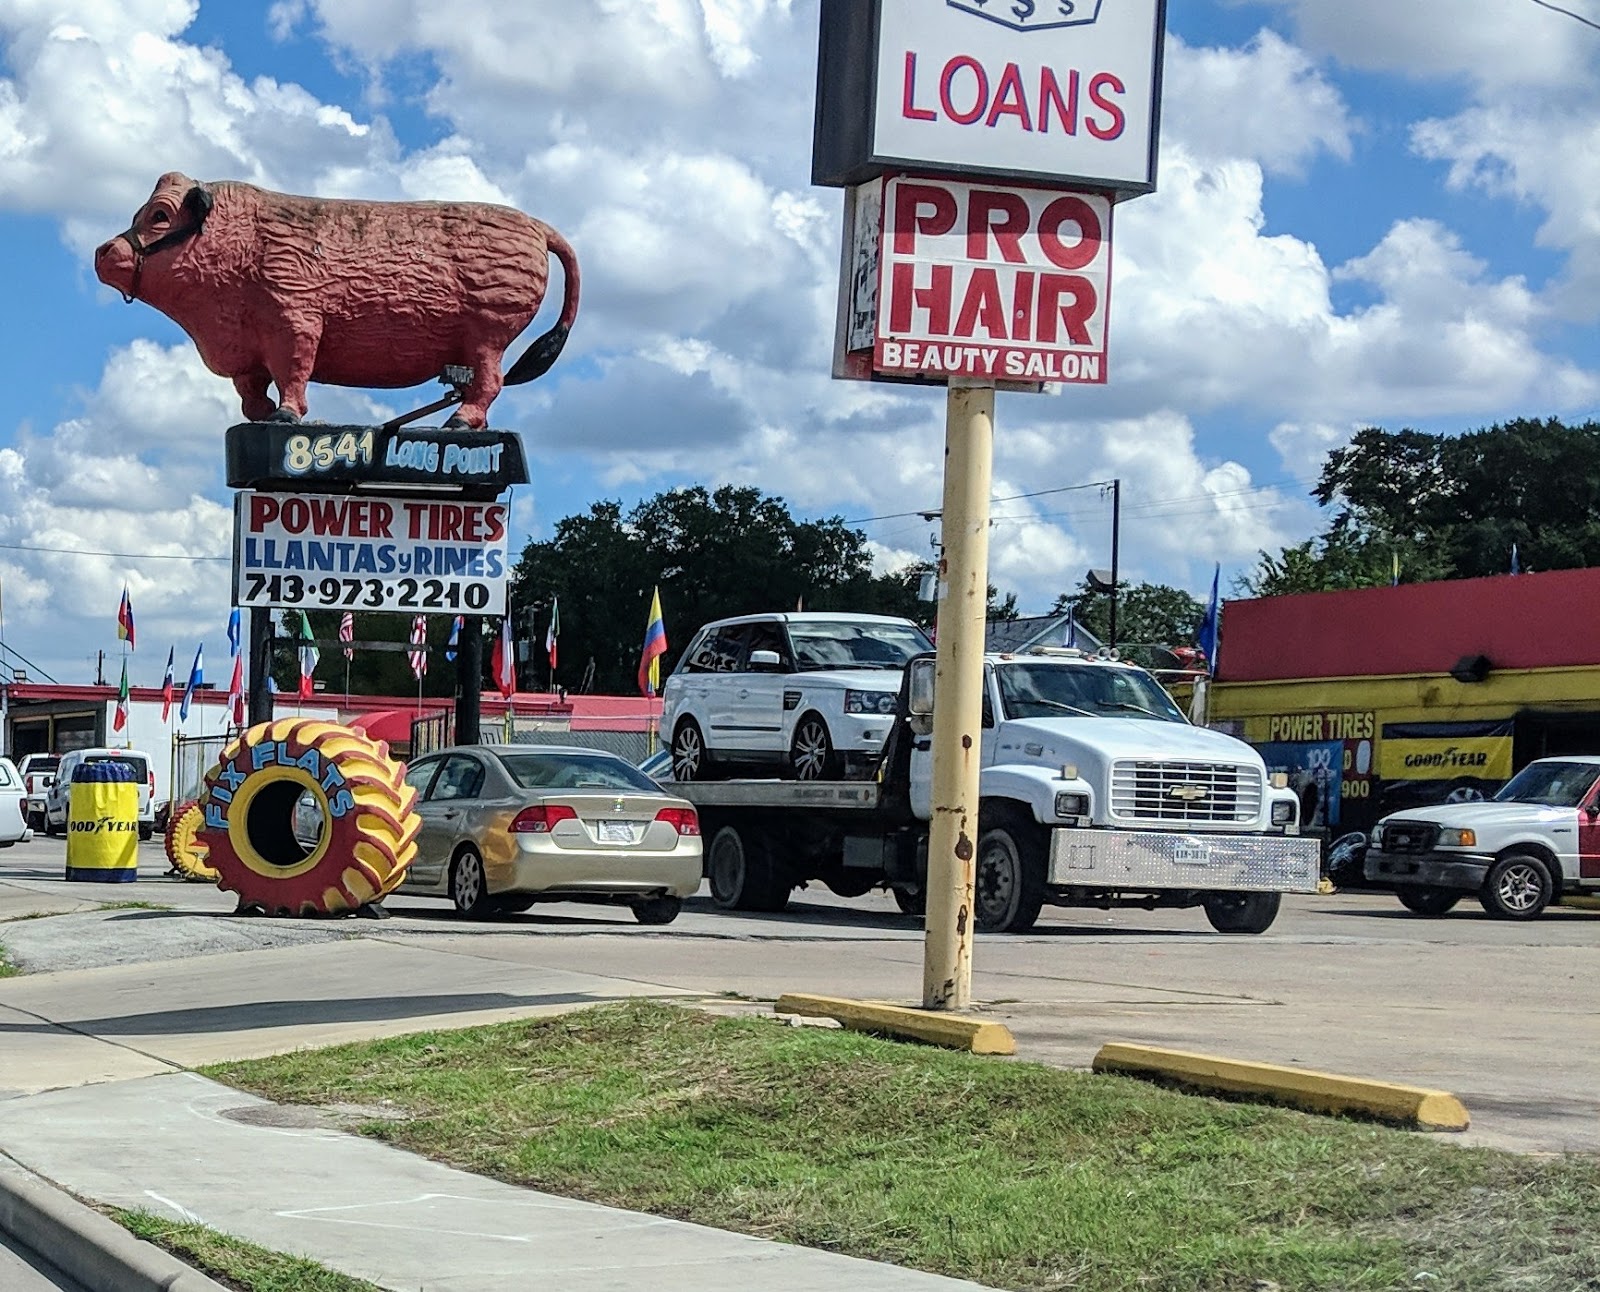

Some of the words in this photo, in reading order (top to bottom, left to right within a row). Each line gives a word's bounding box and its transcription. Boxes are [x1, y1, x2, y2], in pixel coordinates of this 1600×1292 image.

[902, 51, 1126, 141] LOANS
[893, 183, 1102, 270] PRO
[889, 262, 1097, 346] HAIR
[882, 342, 999, 374] BEAUTY
[1005, 350, 1099, 380] SALON
[285, 430, 373, 473] 8541
[386, 435, 439, 472] LONG
[442, 442, 504, 474] POINT
[250, 496, 393, 538] POWER
[404, 501, 505, 542] TIRES
[1270, 715, 1323, 740] POWER
[1327, 712, 1374, 738] TIRES
[205, 761, 247, 829] FIX
[251, 741, 355, 818] FLATS
[71, 819, 137, 833] OODYEAR
